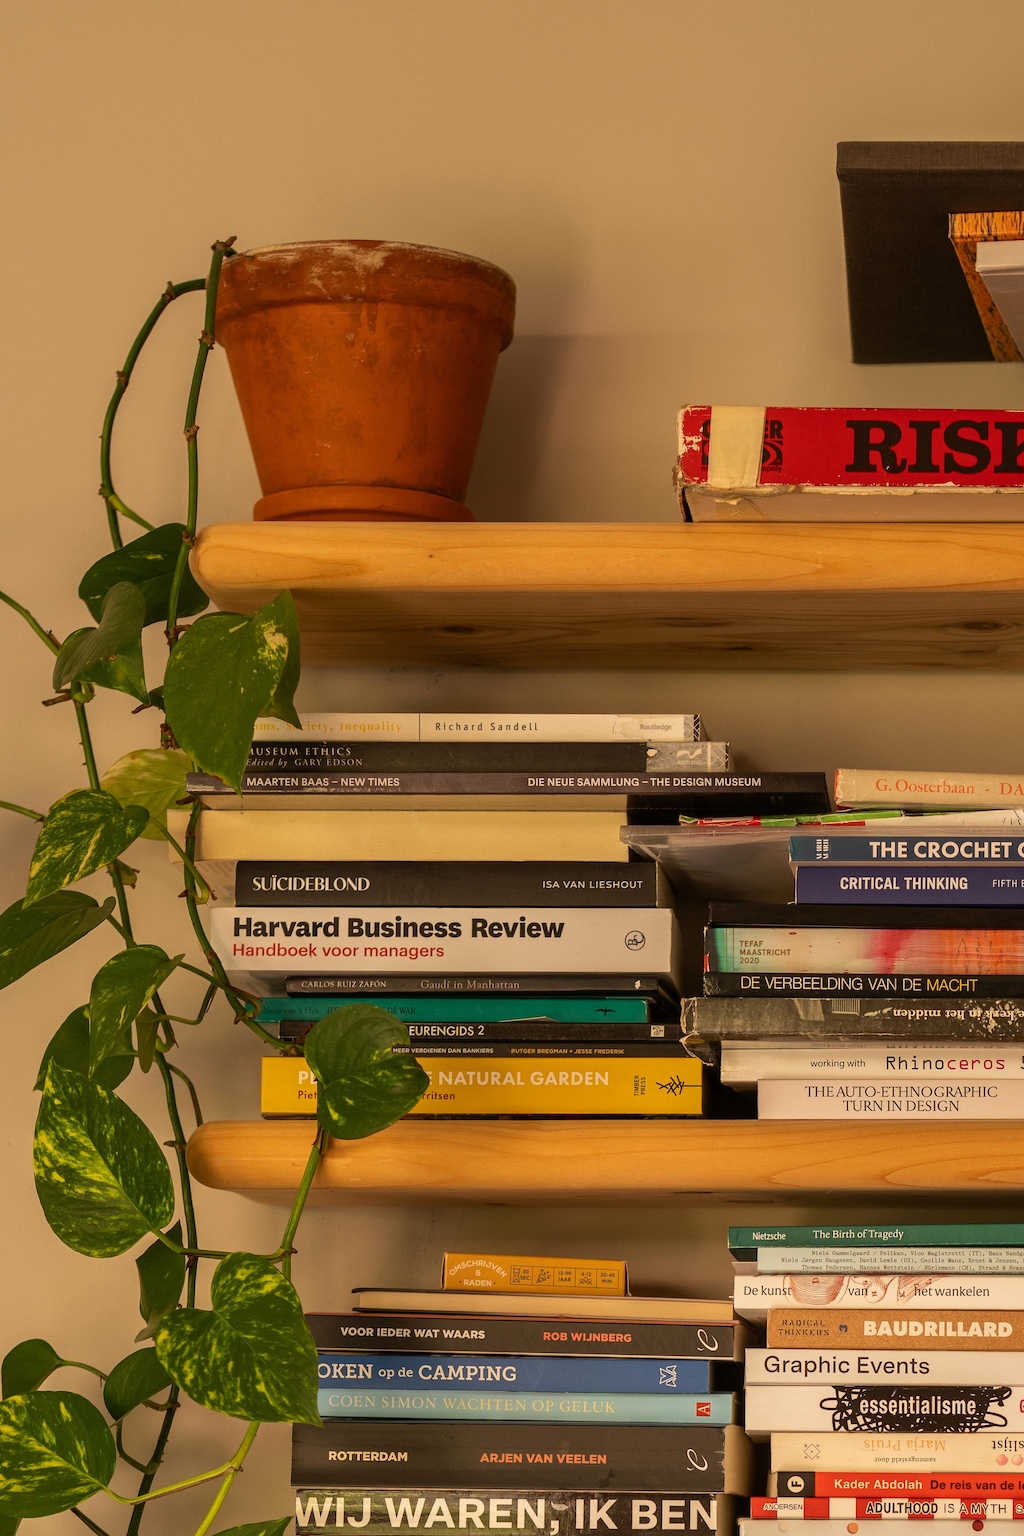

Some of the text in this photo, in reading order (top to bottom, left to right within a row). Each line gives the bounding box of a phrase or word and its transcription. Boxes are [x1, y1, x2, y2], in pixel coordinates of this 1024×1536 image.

[435, 722, 538, 731] Richard Sandell
[869, 842, 908, 858] THE
[913, 841, 1012, 859] CROCHET
[252, 875, 370, 892] SUÏCIDEBLOND
[840, 876, 900, 890] CRITICAL
[904, 877, 968, 890] THINKING
[993, 879, 1019, 888] FIFTH
[234, 916, 564, 938] Harvard Business Review
[740, 940, 763, 948] TEFAF
[233, 944, 444, 960] Handboek voor managers
[741, 977, 977, 992] DE VERBEELDING VAN DE MACHT
[886, 1056, 1005, 1070] Rhinoceros
[439, 1072, 609, 1086] NATURAL GARDEN
[752, 1231, 786, 1241] Nietzsche
[813, 1229, 903, 1243] The Birth of Tragedy
[341, 1327, 485, 1340] VOOR IEDER WAT WAARS
[864, 1320, 1012, 1337] BAUDRILLARD
[543, 1332, 631, 1342] ROB WIJNBERG
[763, 1356, 930, 1377] Graphic Events
[859, 1397, 976, 1416] essentialisme
[296, 1497, 717, 1535] WIJ WAREN, IK BEN
